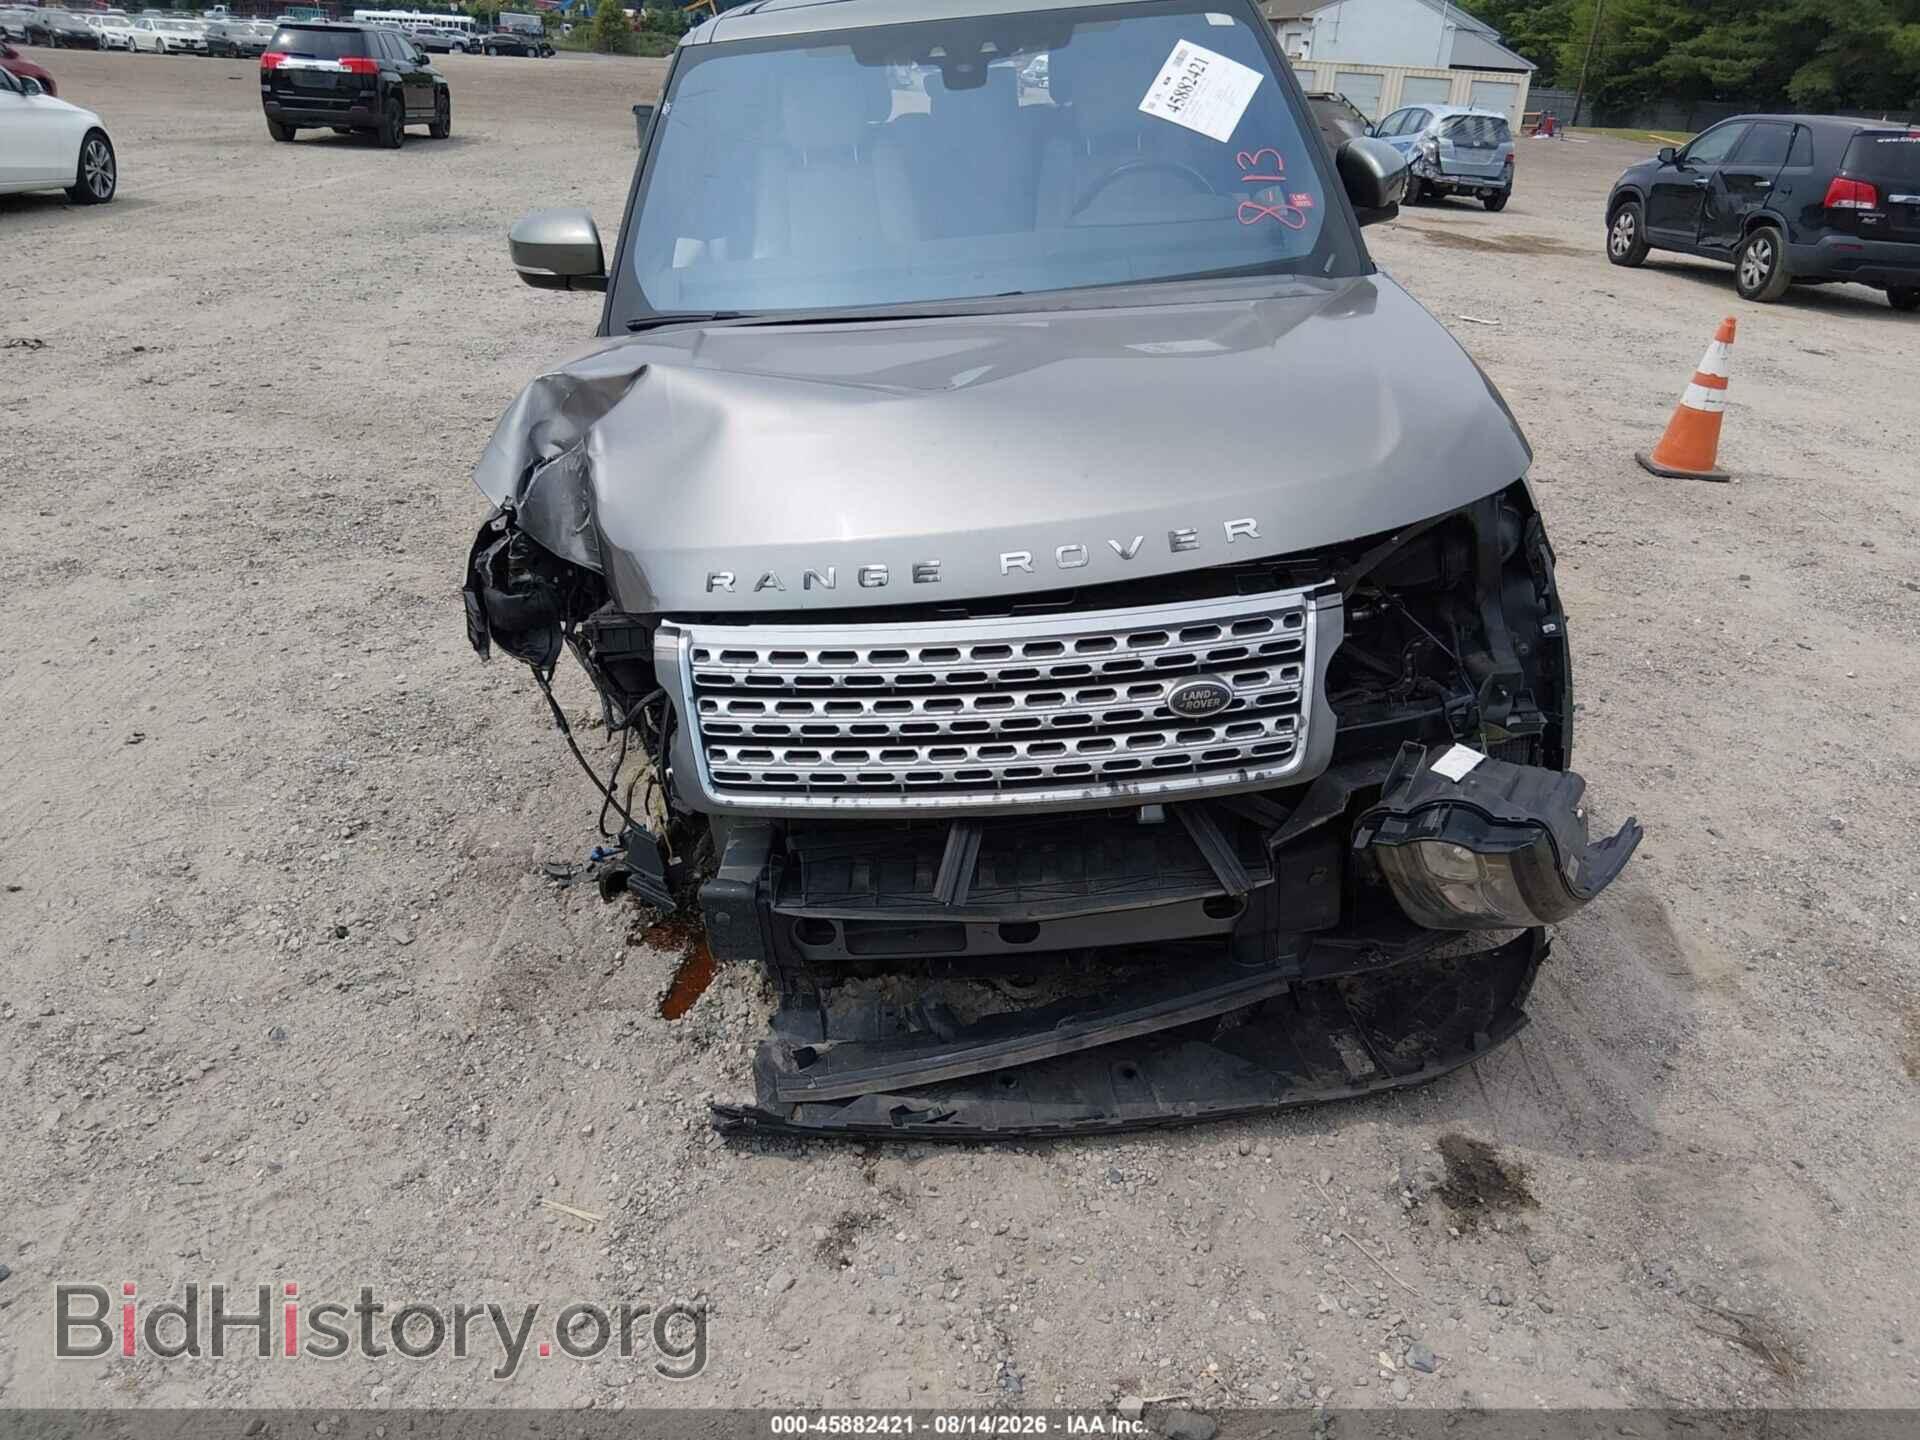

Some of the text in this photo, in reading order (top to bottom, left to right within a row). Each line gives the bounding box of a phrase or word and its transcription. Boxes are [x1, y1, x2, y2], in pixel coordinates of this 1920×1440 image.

[1166, 56, 1209, 113] 45882421
[706, 518, 1261, 593] RANGE ROVER
